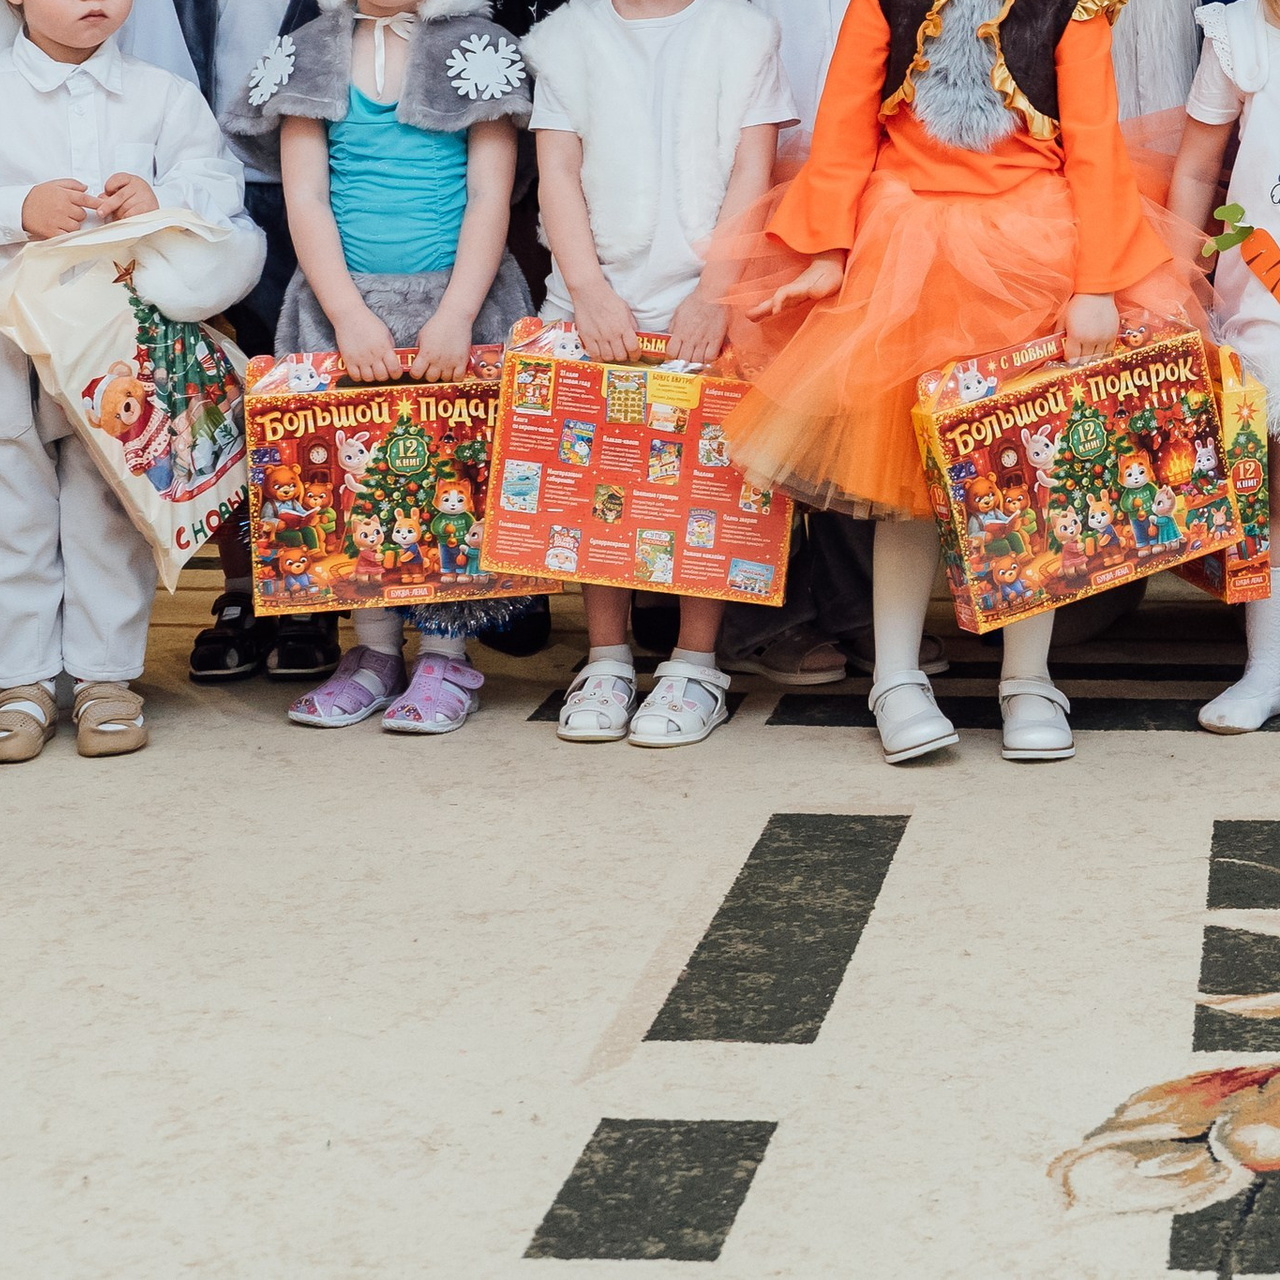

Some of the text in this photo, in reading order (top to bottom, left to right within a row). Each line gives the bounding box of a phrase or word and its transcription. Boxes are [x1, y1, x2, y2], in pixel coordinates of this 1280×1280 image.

[638, 336, 667, 353] ВЫМ
[1000, 355, 1009, 370] С
[1012, 340, 1058, 367] НОВЫМ
[1078, 422, 1097, 442] 12
[397, 439, 417, 457] 12
[1078, 439, 1102, 453] КНИГ
[395, 457, 422, 467] КНИГ
[1237, 461, 1256, 479] 12
[1236, 478, 1259, 488] КНИГ
